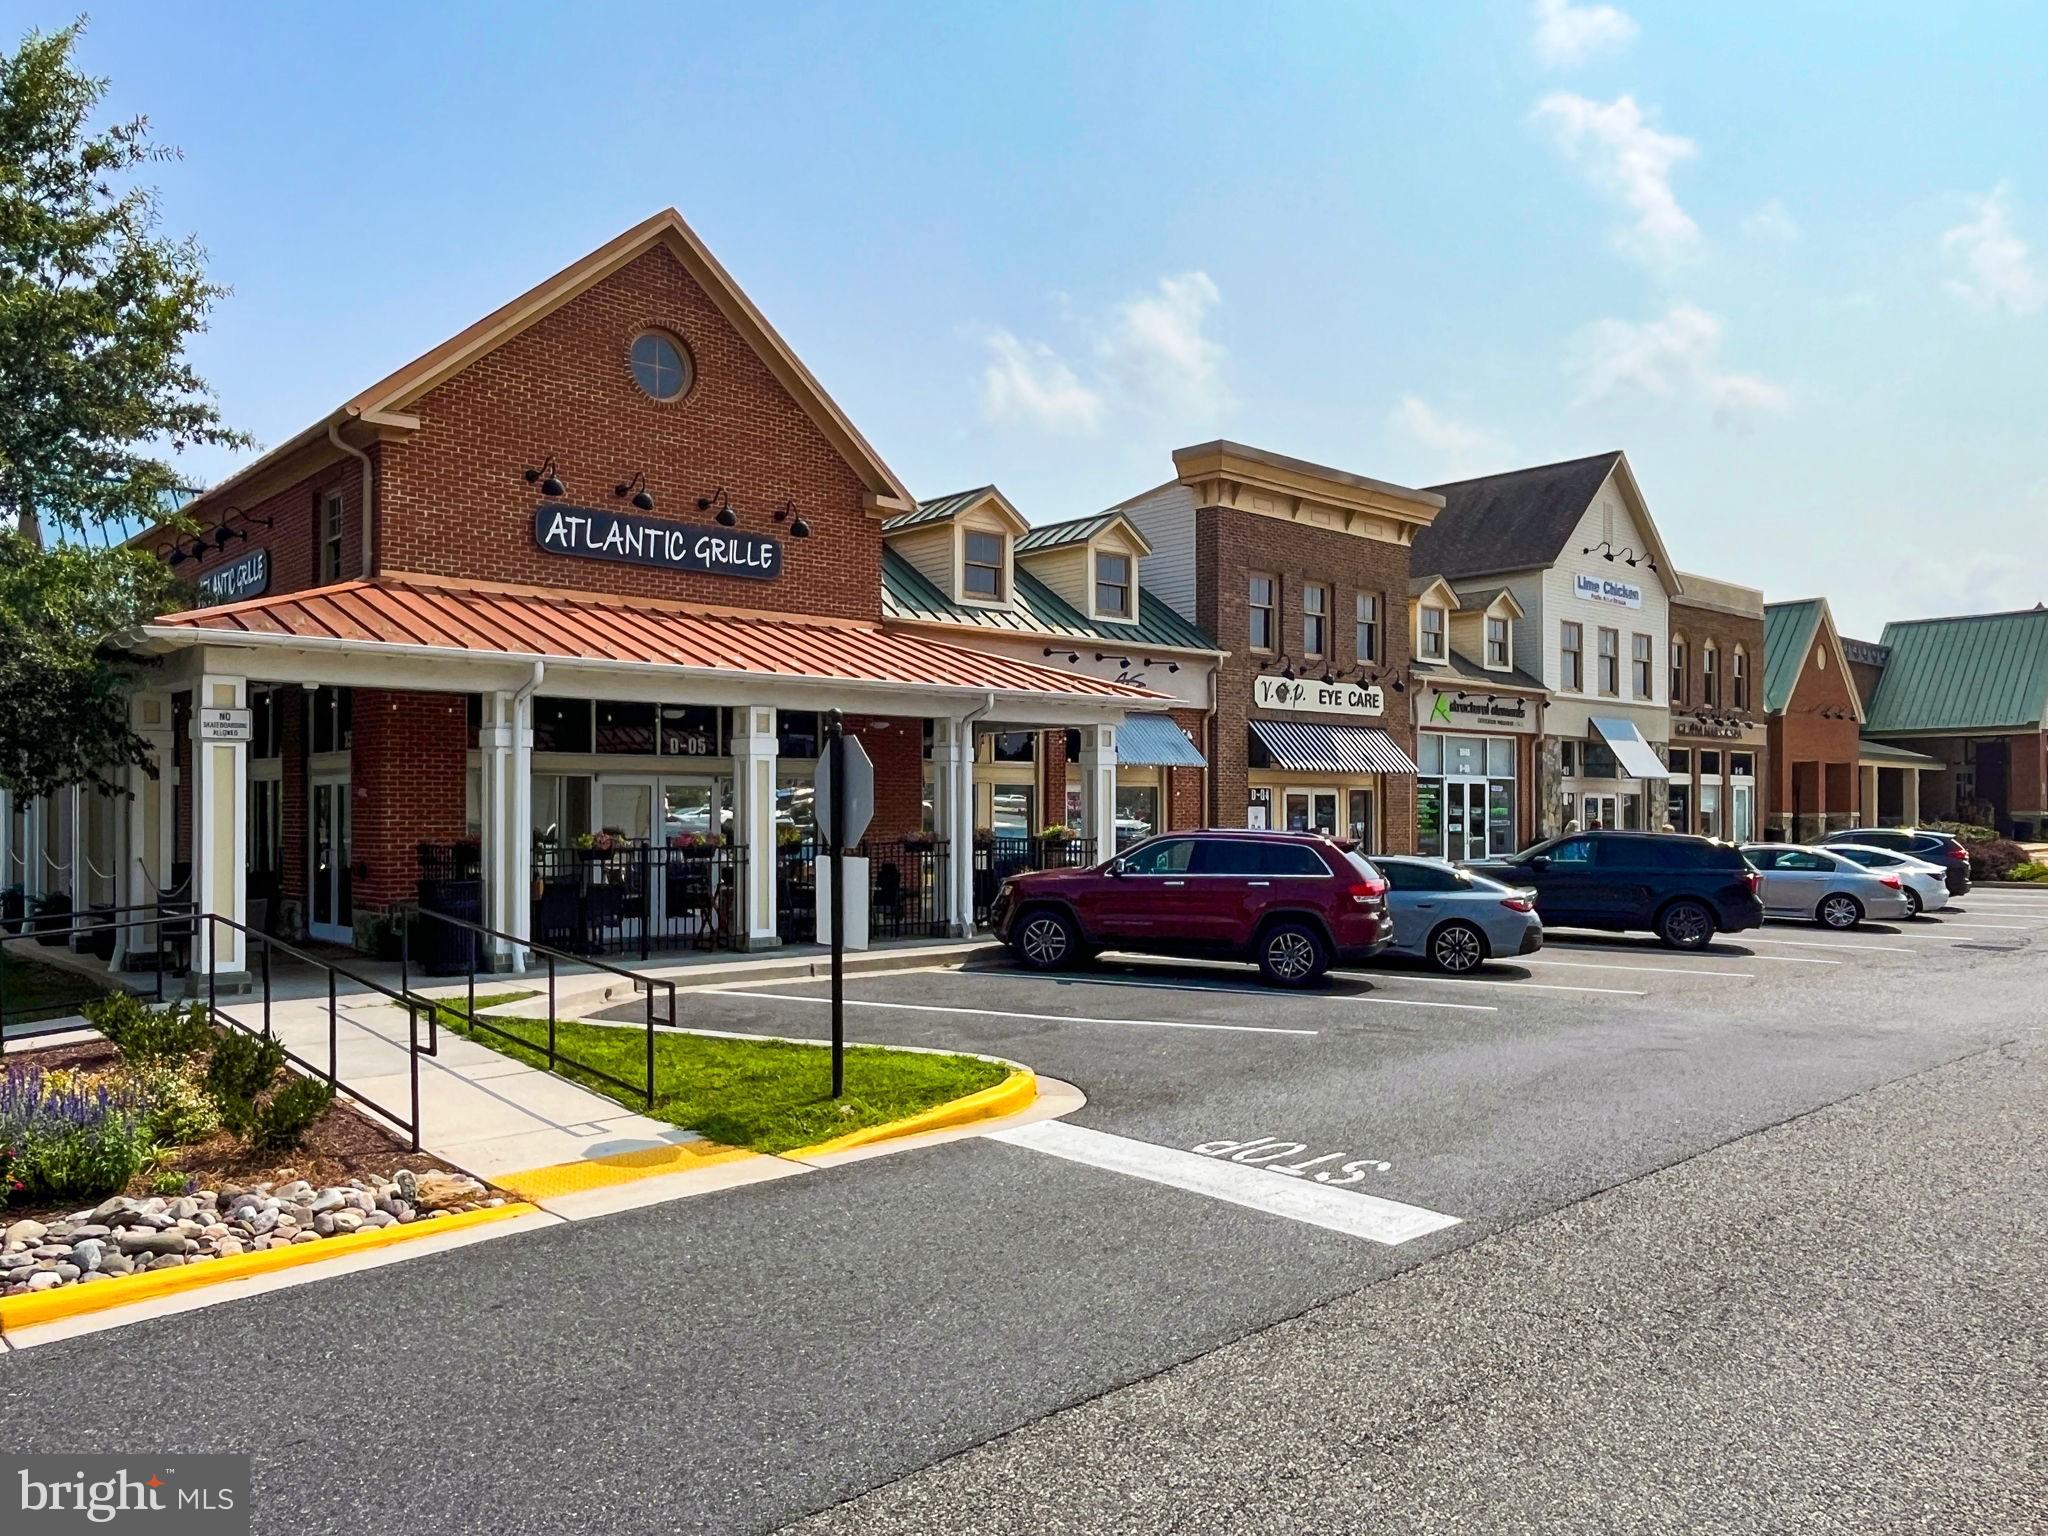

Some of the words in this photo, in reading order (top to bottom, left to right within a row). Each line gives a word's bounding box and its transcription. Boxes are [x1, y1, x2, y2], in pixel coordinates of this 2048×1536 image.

[545, 512, 686, 561] ATLANTIC
[695, 536, 773, 568] GRILLE
[1577, 575, 1600, 593] Lime
[1318, 689, 1342, 706] EYE
[1348, 691, 1380, 709] CARE
[219, 712, 231, 721] NO
[670, 737, 706, 755] D-05
[1192, 1136, 1392, 1184] STOP
